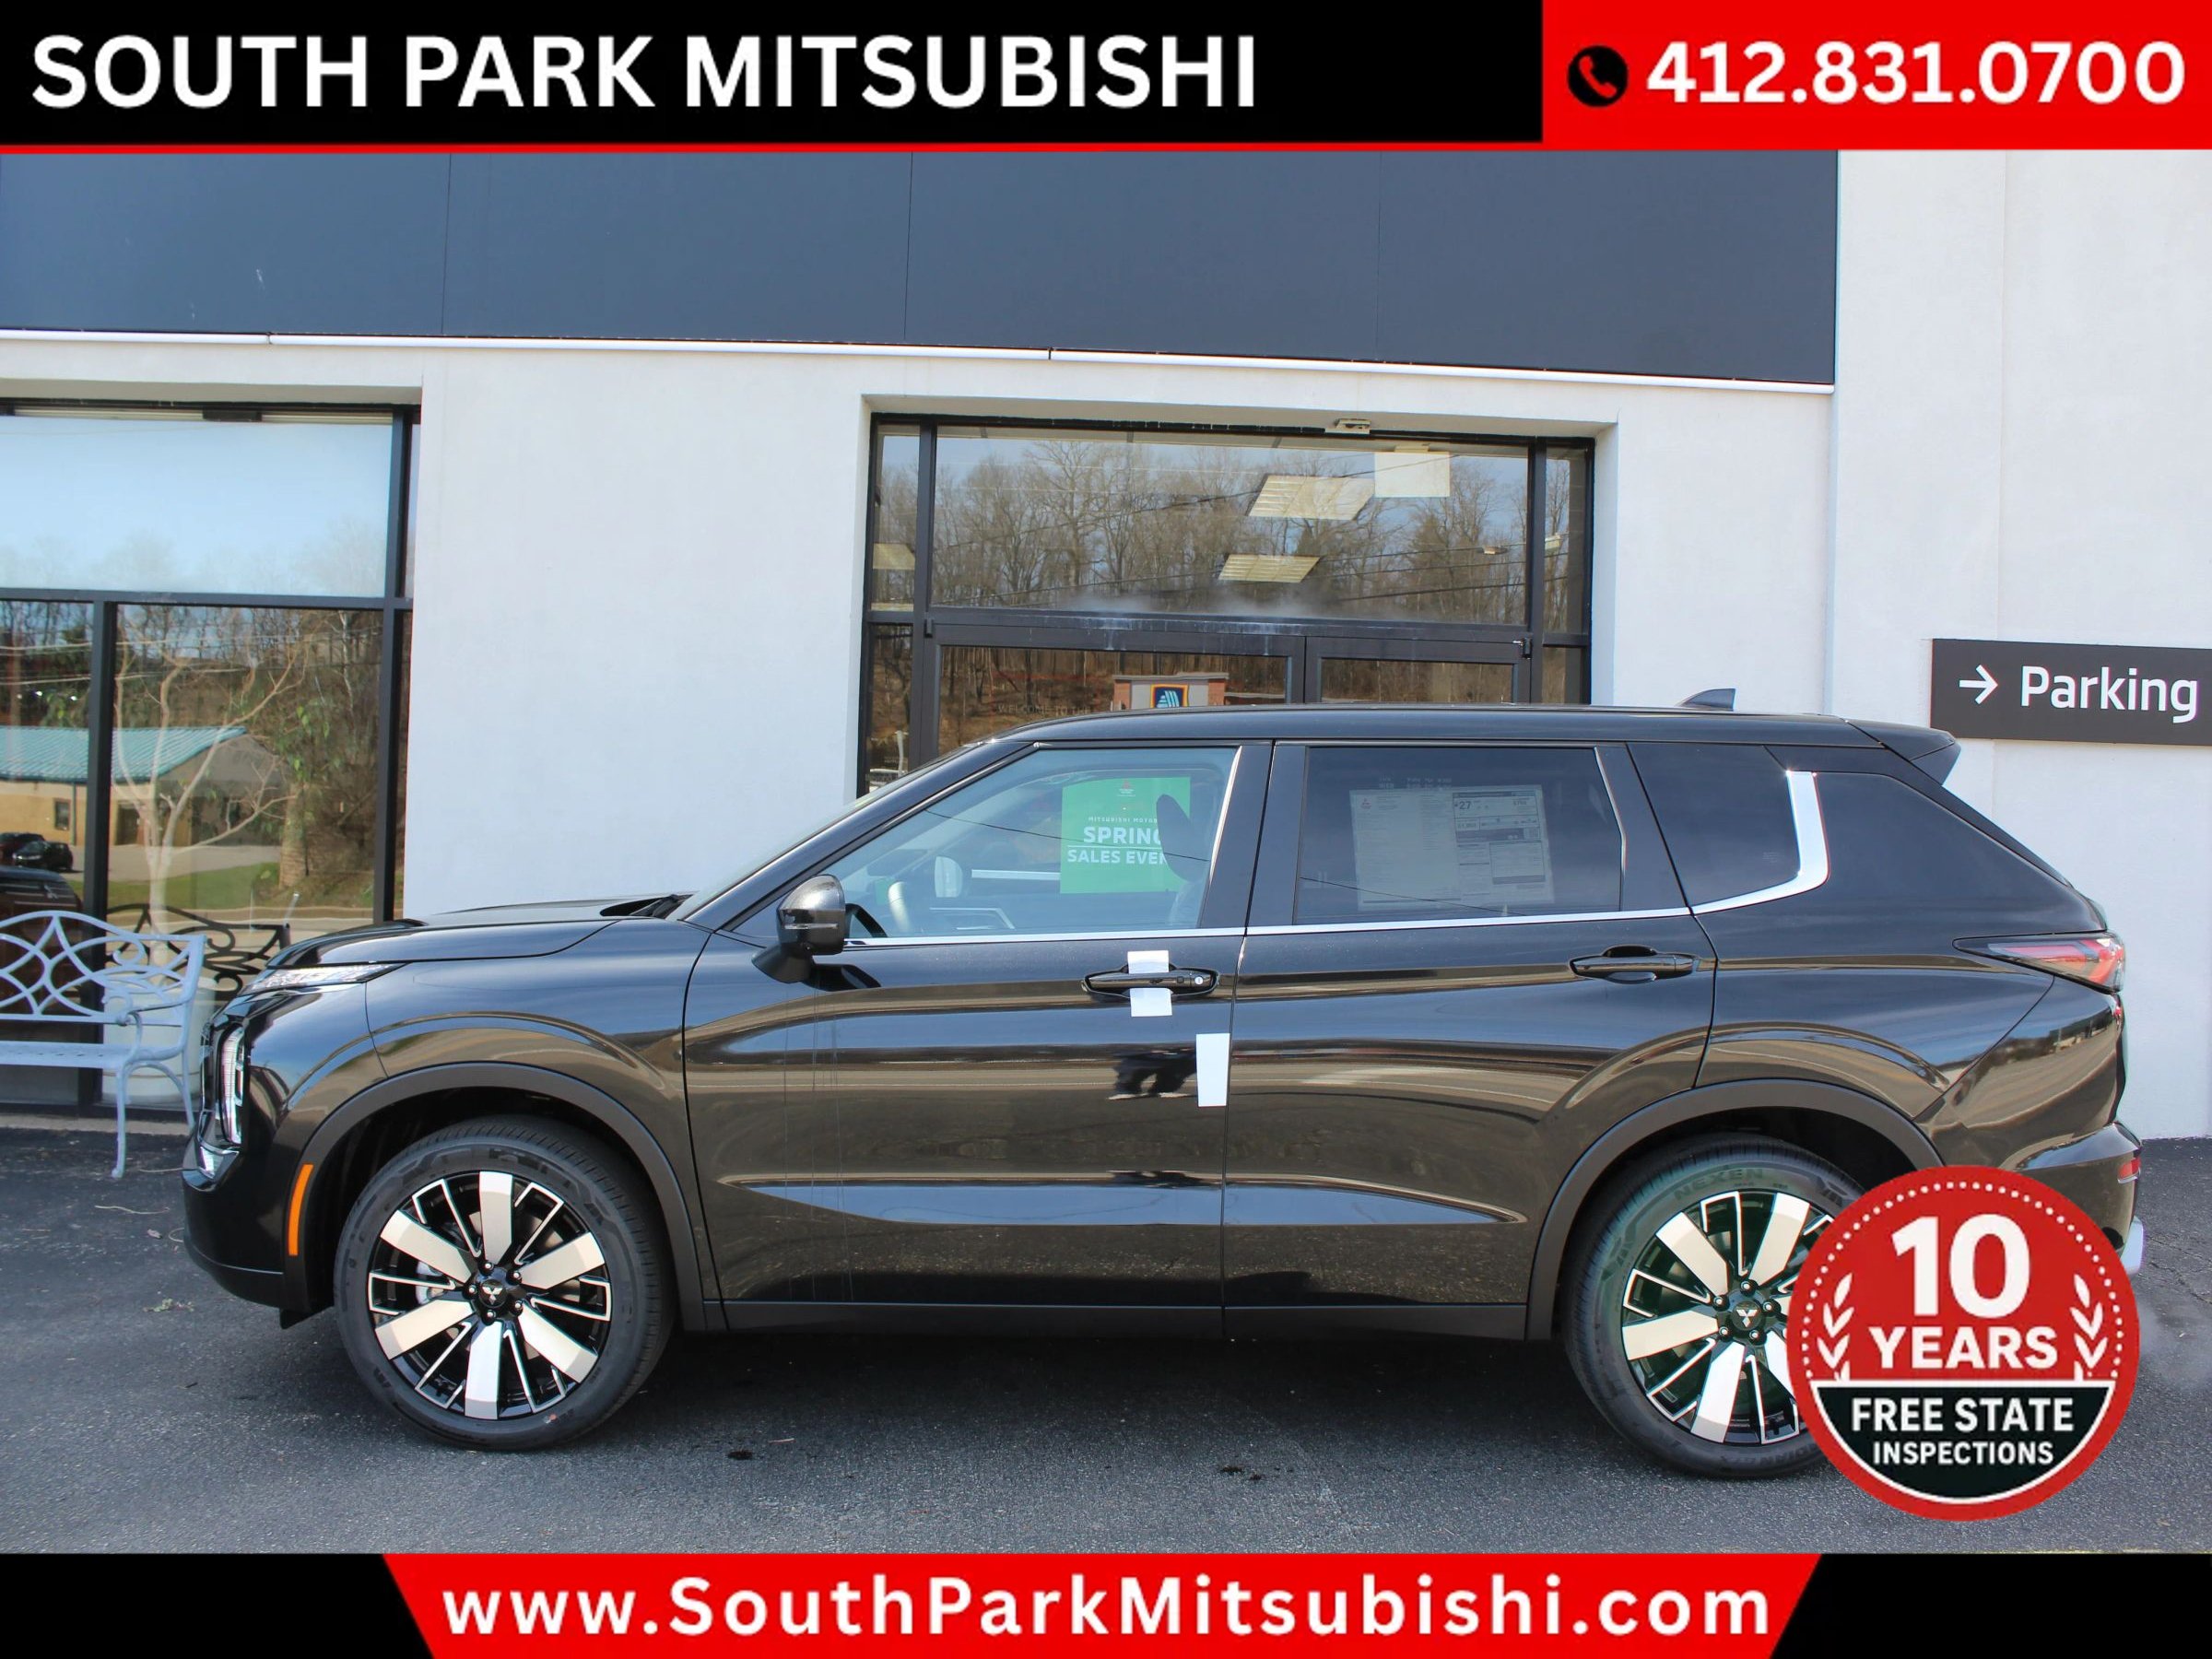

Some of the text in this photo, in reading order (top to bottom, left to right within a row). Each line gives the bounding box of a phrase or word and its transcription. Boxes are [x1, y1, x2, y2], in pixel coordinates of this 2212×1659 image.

[2021, 665, 2199, 724] Parking
[1459, 800, 1472, 810] 27
[1067, 849, 1168, 865] SALES EVEN
[1673, 1168, 1763, 1200] NEXEN
